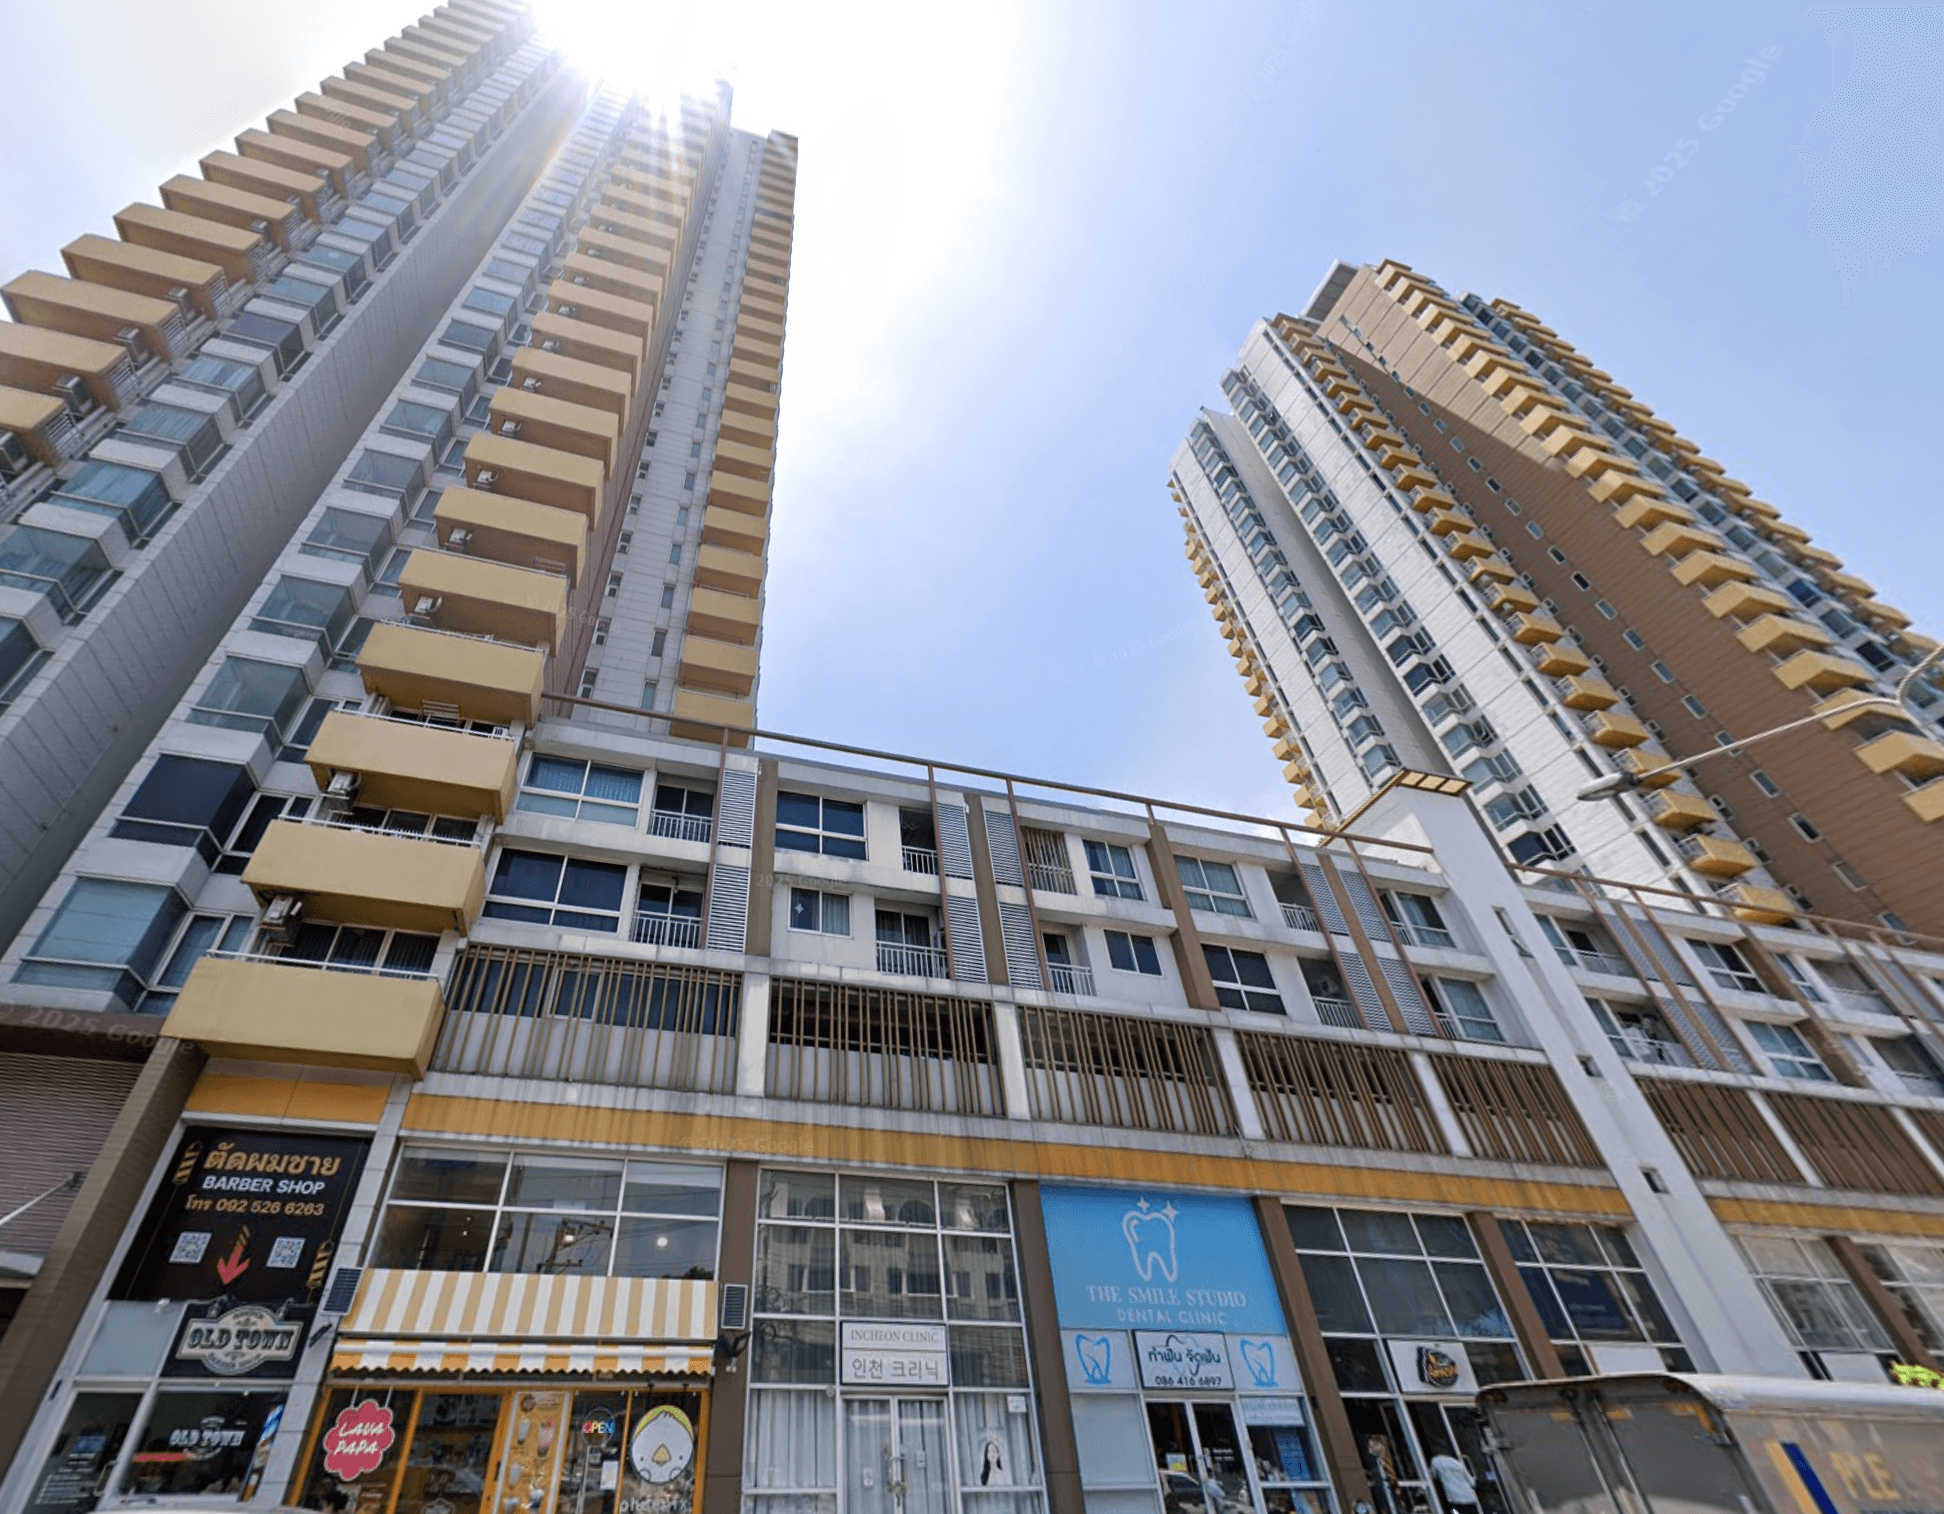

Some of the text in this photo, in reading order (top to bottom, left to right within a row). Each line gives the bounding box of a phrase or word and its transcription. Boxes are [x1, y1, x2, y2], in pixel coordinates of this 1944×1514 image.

[203, 1142, 342, 1176] ตัดผมชาย
[202, 1175, 325, 1195] BARBER SHOP
[215, 1198, 248, 1213] 092
[1086, 1285, 1246, 1308] THE SMILE STUDIO
[1117, 1308, 1229, 1326] DENTAL CLINIC
[187, 1327, 295, 1351] OLD TOWN
[851, 1329, 940, 1343] INCHEON CLINIC
[852, 1358, 938, 1381] 인천 크리닉
[169, 1429, 200, 1447] OLD
